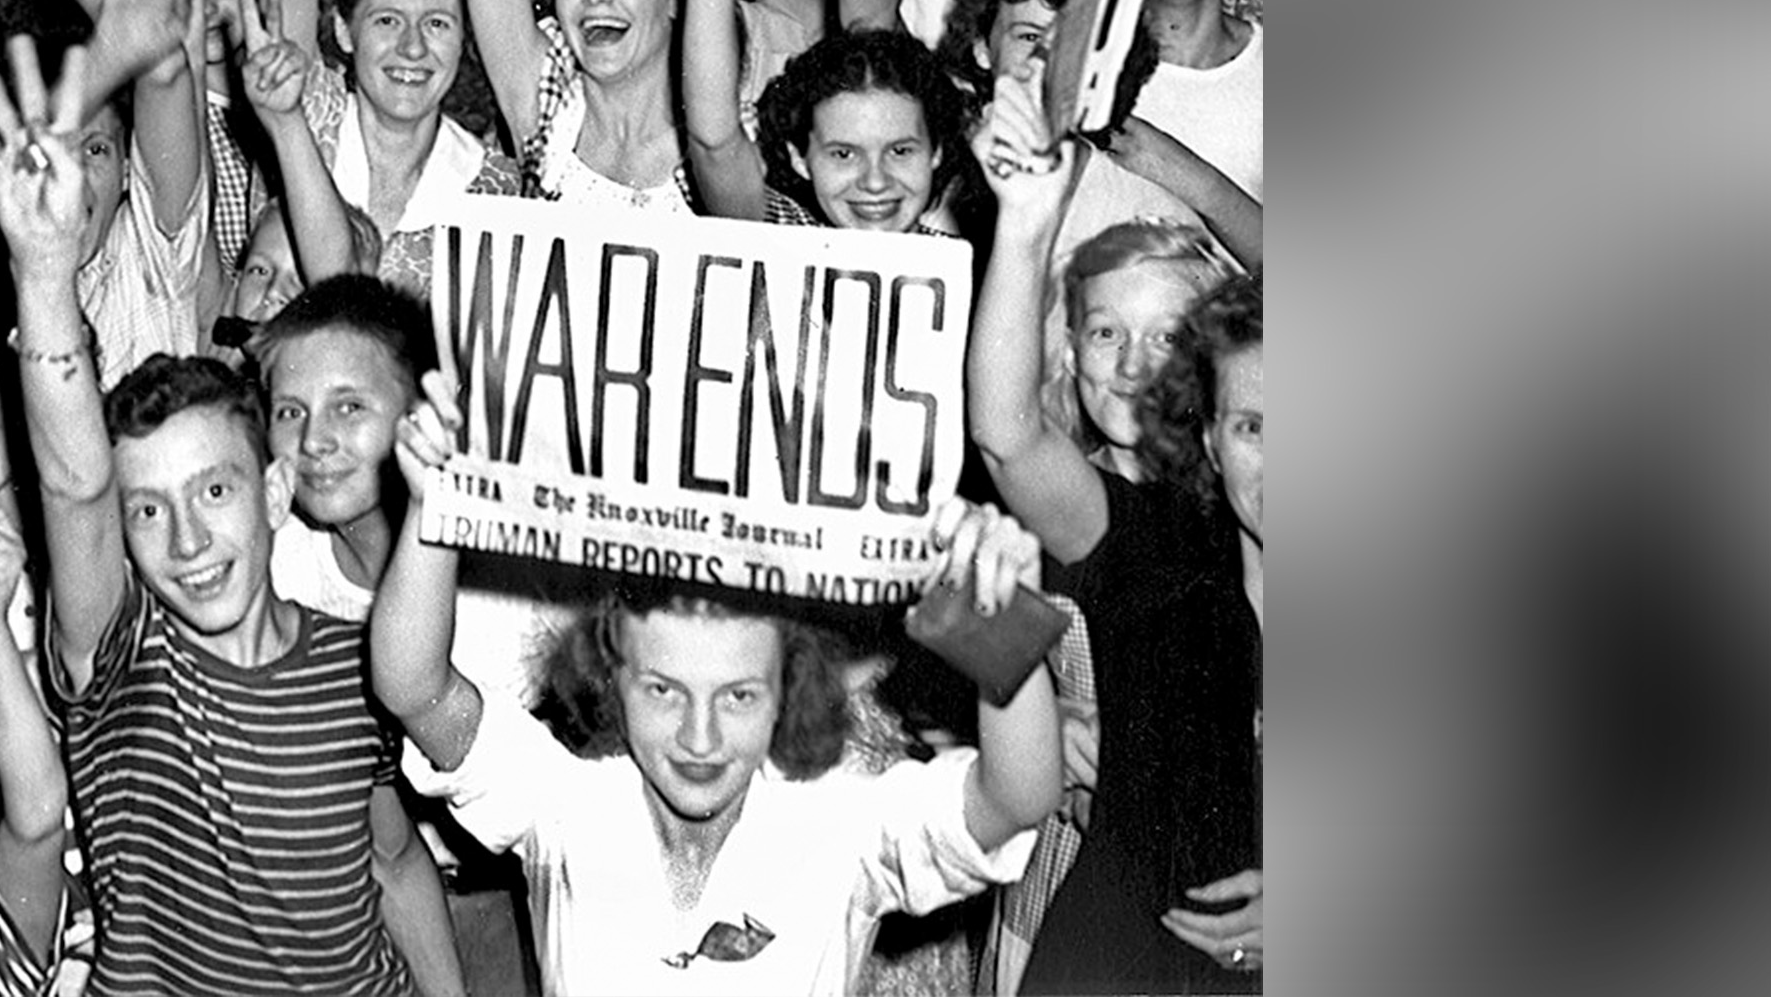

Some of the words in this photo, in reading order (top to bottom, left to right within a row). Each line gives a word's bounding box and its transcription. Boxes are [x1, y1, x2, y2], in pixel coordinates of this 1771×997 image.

[447, 225, 660, 485] WAR
[678, 253, 946, 518] ENDS
[436, 514, 562, 560] TRUMAN
[582, 537, 724, 585] REPORTS
[745, 561, 786, 594] TO
[533, 485, 576, 514] The
[586, 492, 710, 533] Knoxville
[721, 512, 824, 550] Journal
[860, 535, 928, 561] EXTRA
